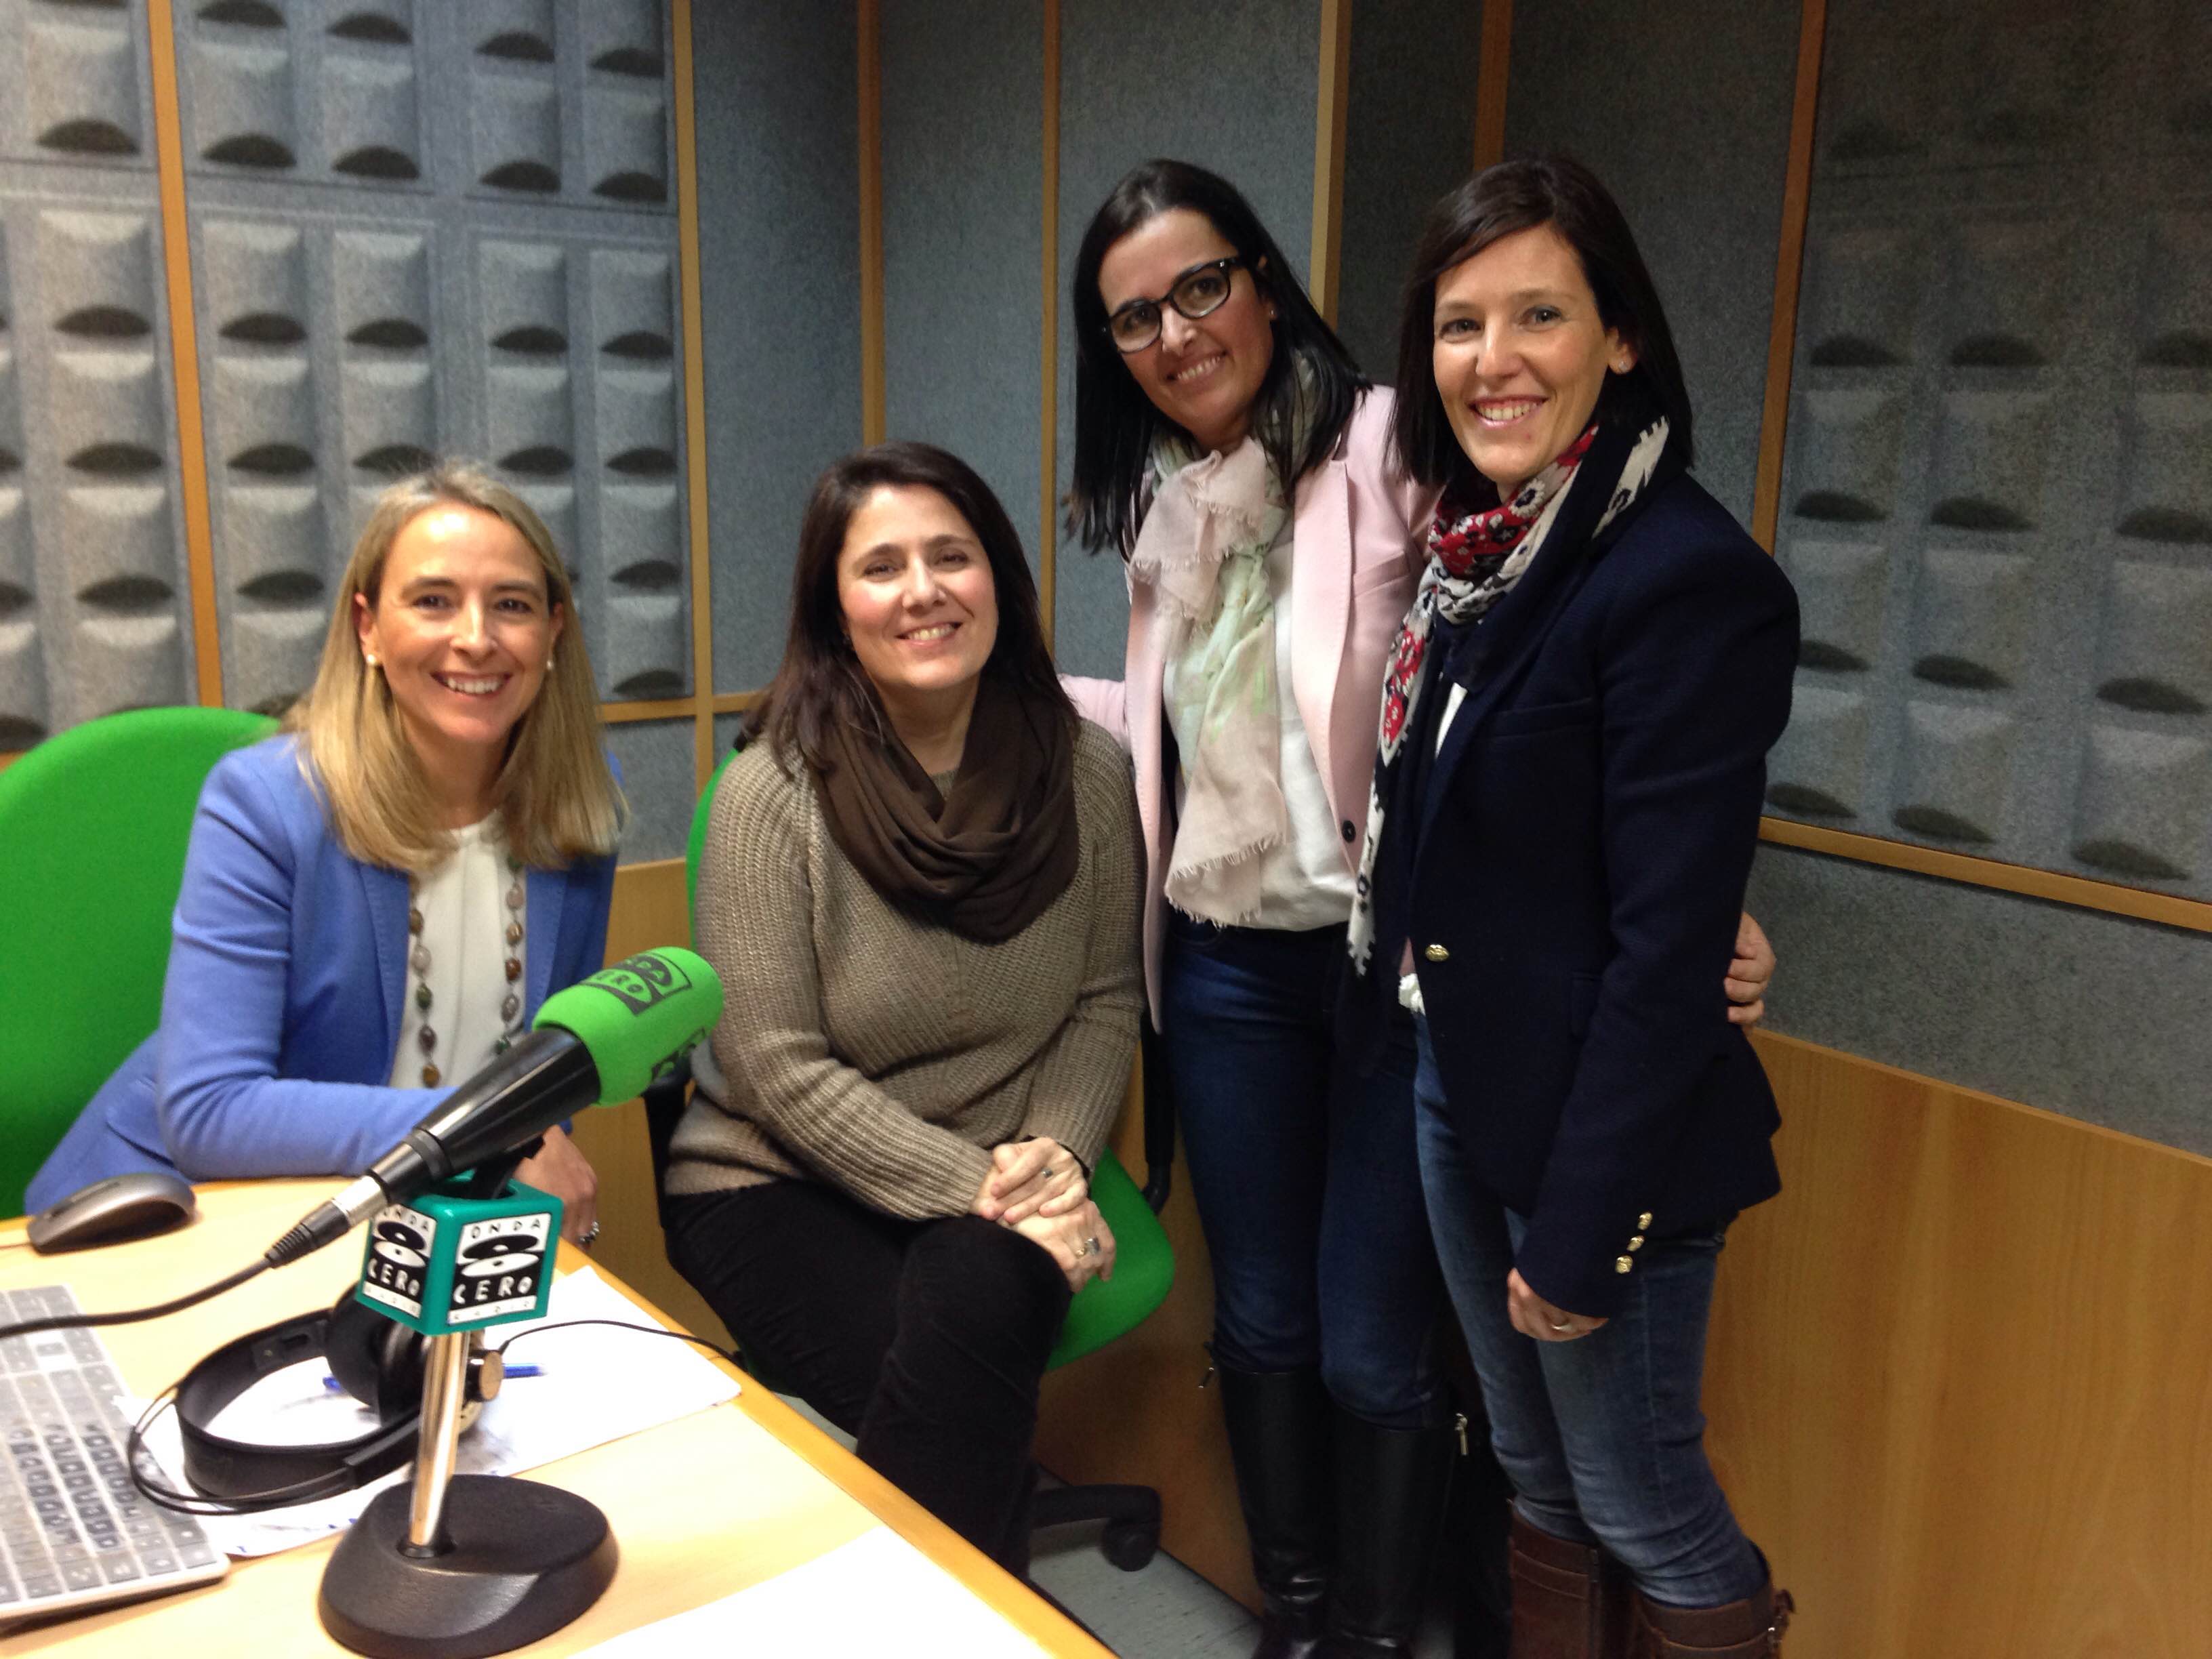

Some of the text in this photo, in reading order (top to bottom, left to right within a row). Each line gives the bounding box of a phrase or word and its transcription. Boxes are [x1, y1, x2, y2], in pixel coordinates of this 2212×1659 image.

[471, 1218, 541, 1239] ONDA
[367, 1257, 420, 1296] CERO
[453, 1276, 533, 1305] CERO
